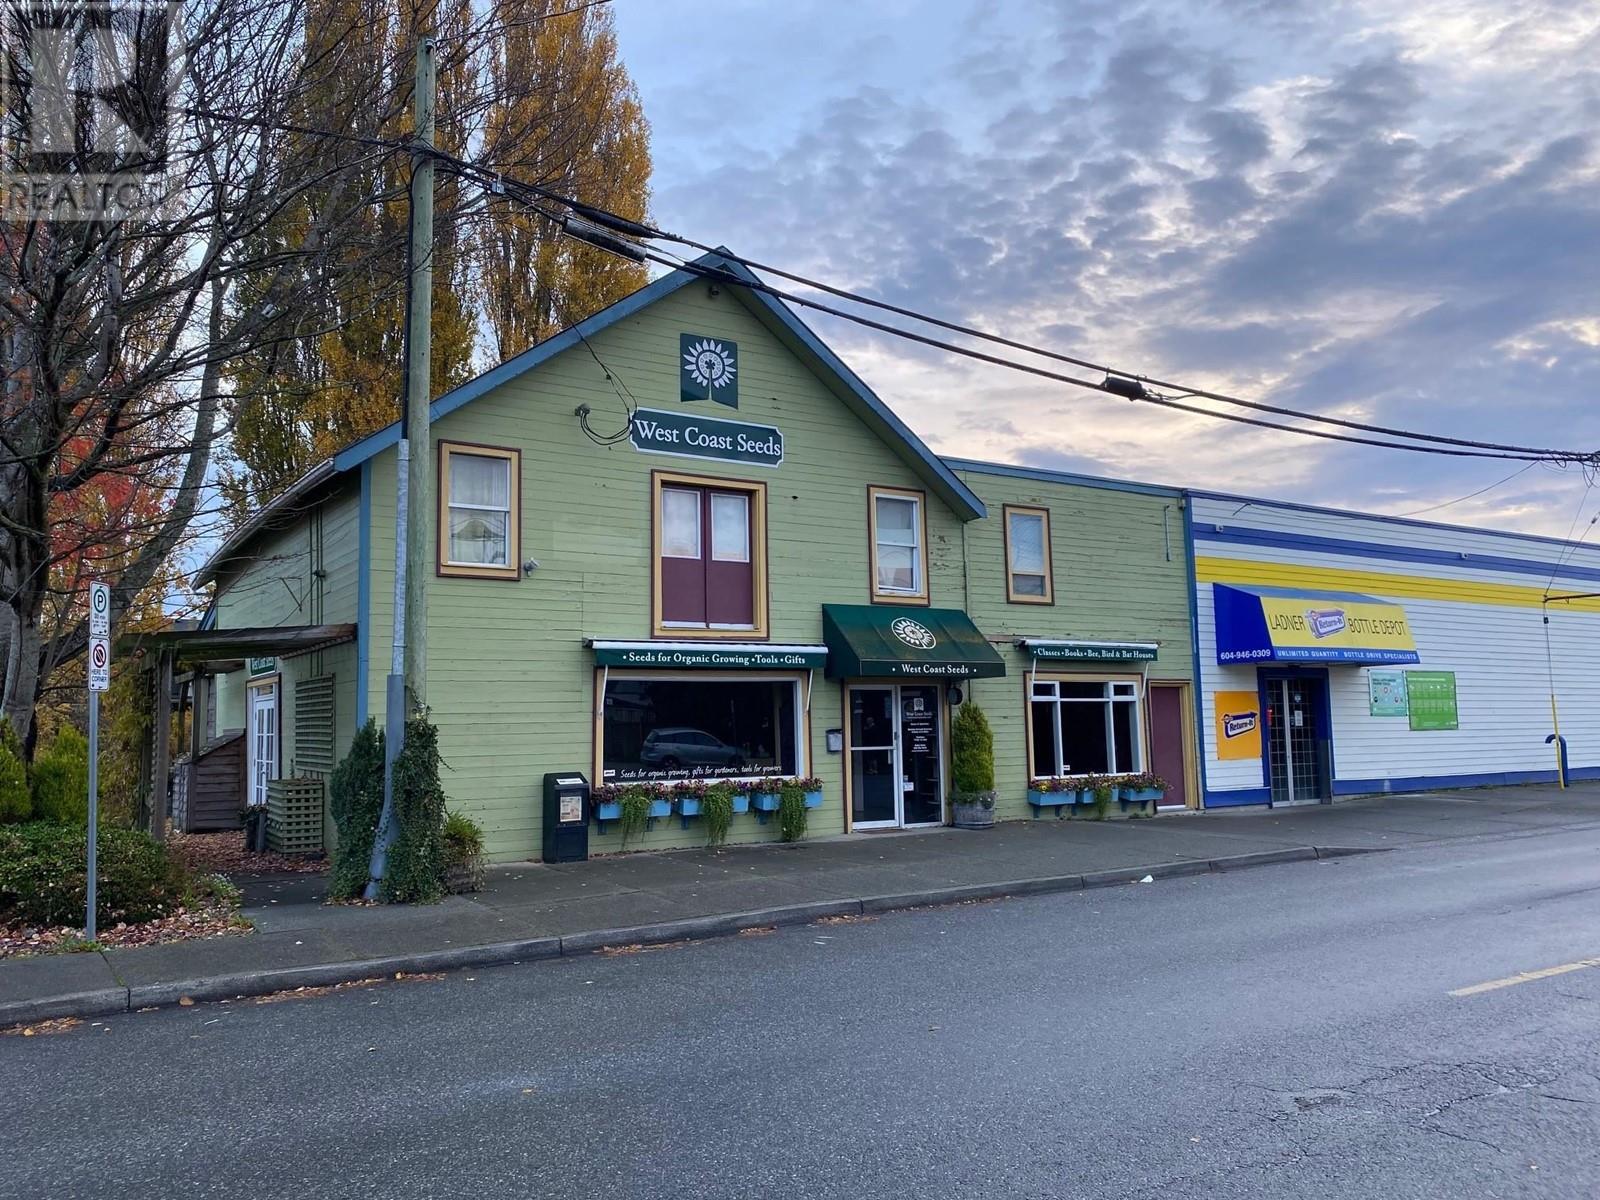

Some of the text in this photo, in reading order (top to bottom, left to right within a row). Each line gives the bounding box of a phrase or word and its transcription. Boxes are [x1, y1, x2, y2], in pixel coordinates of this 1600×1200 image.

[634, 419, 781, 456] West Coast Seeds
[1268, 614, 1406, 636] LADNER BOTTLE DEPOT
[629, 652, 806, 666] Seeds for Organic Growing Tools Gifts
[1037, 648, 1060, 656] Classes
[1064, 648, 1083, 657] Books
[1102, 650, 1114, 658] Bird
[1133, 651, 1154, 659] Houses
[1220, 649, 1271, 660] 604-946-0309
[901, 663, 969, 674] West Coast Seeds
[621, 769, 636, 778] Seeds
[637, 768, 645, 778] for
[647, 770, 666, 780] organic
[705, 765, 713, 775] for
[741, 764, 753, 773] tools
[753, 763, 761, 773] for
